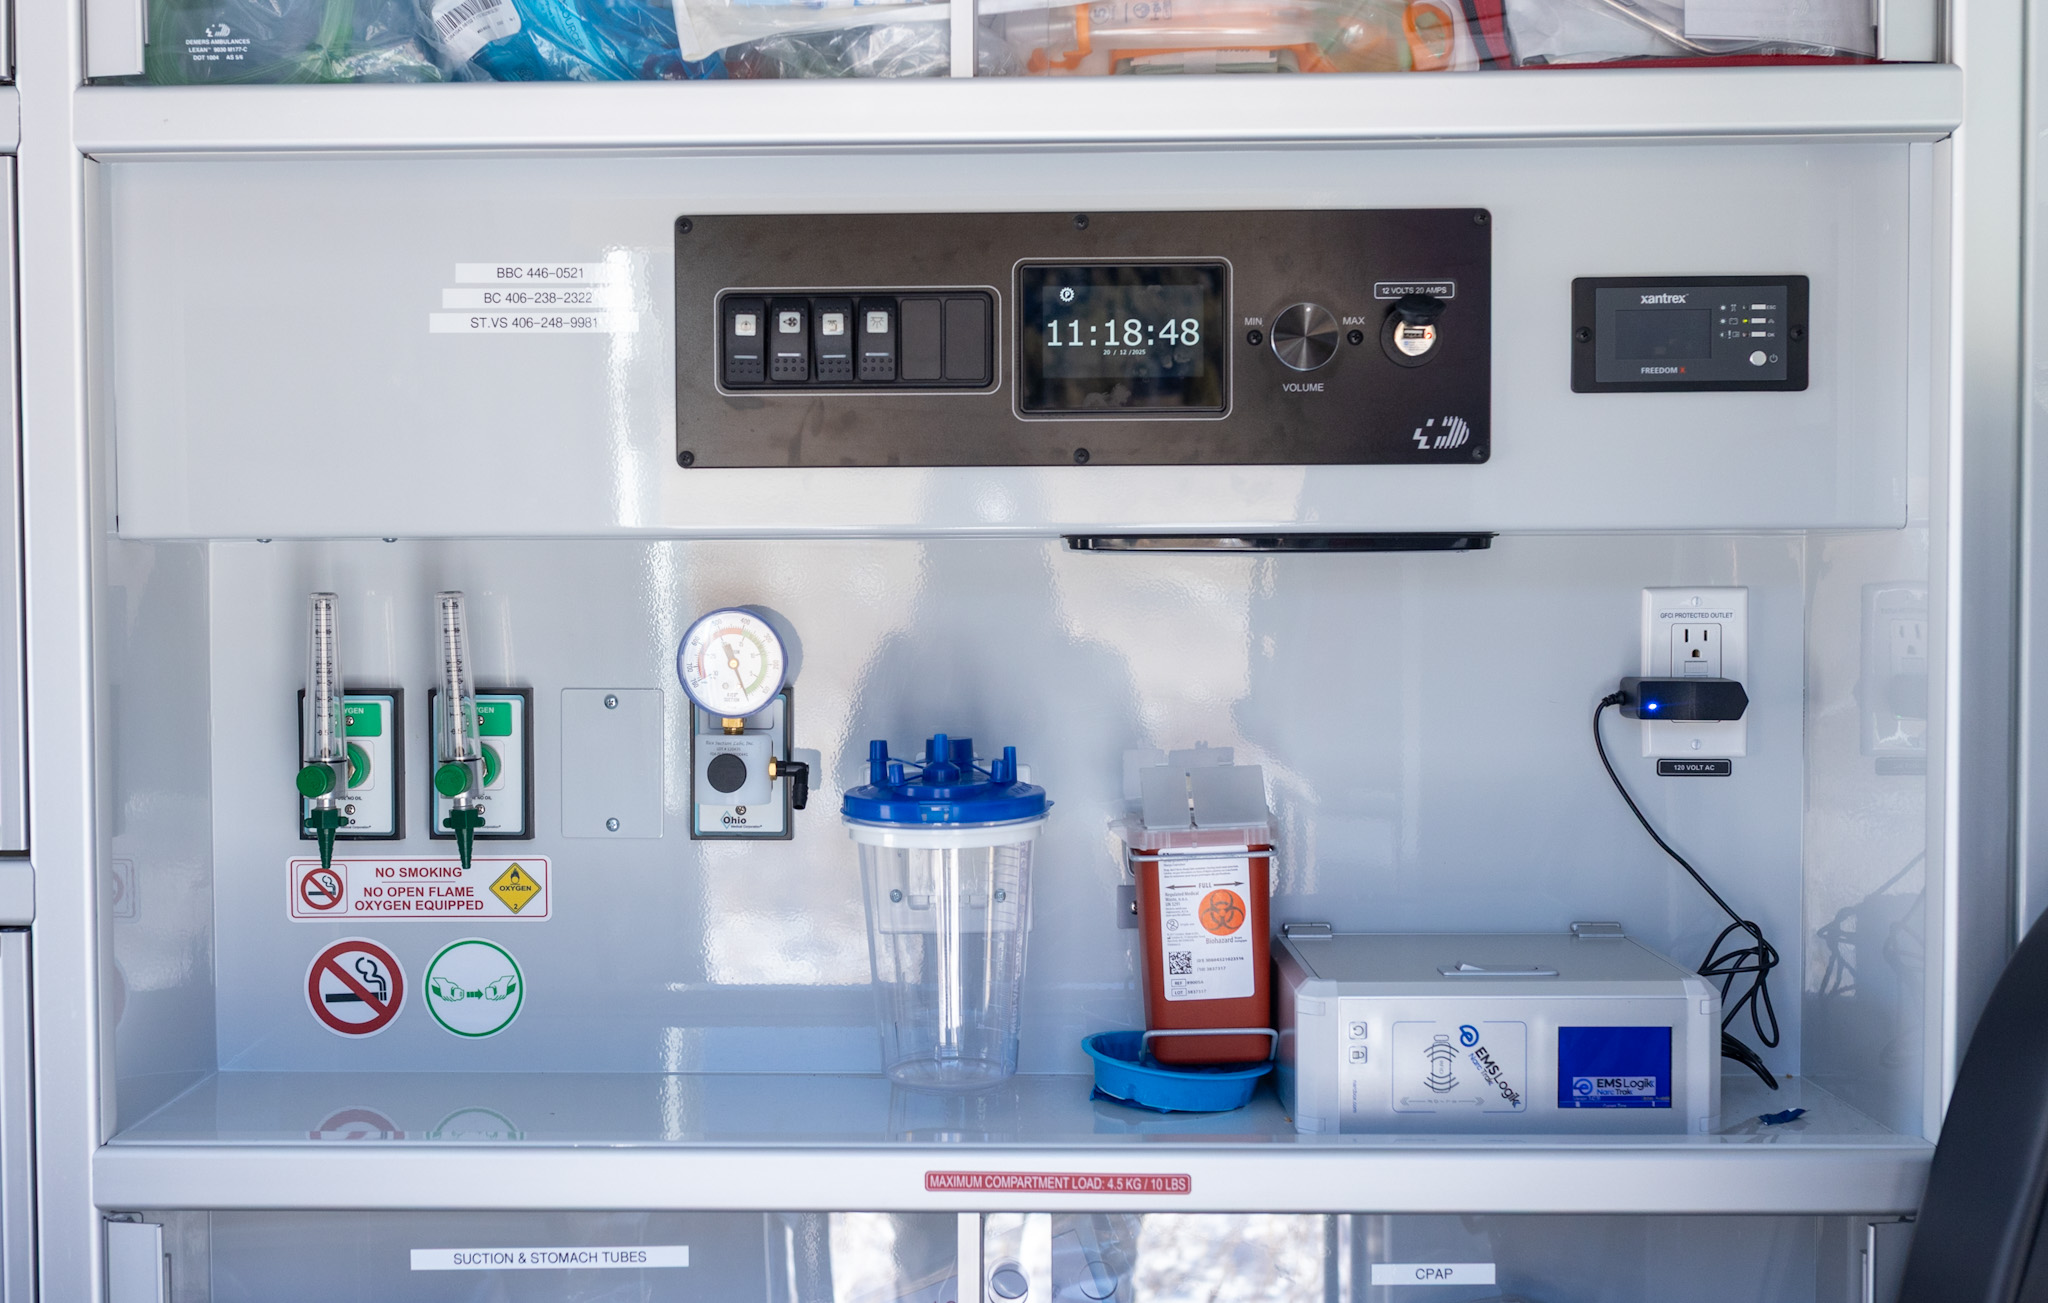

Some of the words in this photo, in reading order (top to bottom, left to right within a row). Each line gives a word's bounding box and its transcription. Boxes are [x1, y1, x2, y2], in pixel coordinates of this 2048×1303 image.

[496, 267, 523, 279] BBC
[526, 267, 584, 279] 446-0521
[1426, 286, 1448, 294] AMPS
[484, 292, 502, 304] BC
[505, 292, 592, 304] 406-238-2322
[470, 317, 508, 329] ST.VS
[512, 317, 598, 329] 406-248-9981
[1244, 317, 1263, 326] MIN
[1342, 316, 1366, 326] MAX
[1047, 318, 1200, 347] 11:18:48
[1282, 383, 1324, 392] VOLUME
[740, 617, 751, 626] 400
[686, 662, 694, 674] 700
[723, 816, 747, 824] Ohio
[376, 868, 395, 878] NO
[399, 867, 462, 878] SMOKING
[364, 887, 384, 897] NO
[387, 887, 425, 897] OPEN
[429, 887, 474, 897] FLAME
[354, 901, 412, 911] OXYGEN
[415, 900, 484, 910] EQUIPPED
[1468, 1052, 1482, 1070] Narc
[1481, 1068, 1494, 1086] Trak
[930, 1176, 982, 1188] MAXIMUM
[985, 1176, 1070, 1189] COMPARTMENT
[1072, 1177, 1105, 1190] LOAD:
[1107, 1177, 1123, 1190] 4.5
[1125, 1178, 1142, 1190] KG
[1144, 1178, 1148, 1190] /
[1150, 1178, 1163, 1190] 10
[1165, 1178, 1186, 1190] LBS
[453, 1253, 514, 1265] SUCTION
[518, 1252, 527, 1264] &
[530, 1252, 598, 1264] STOMACH
[602, 1251, 647, 1263] TUBES
[1415, 1268, 1453, 1280] CPAP
